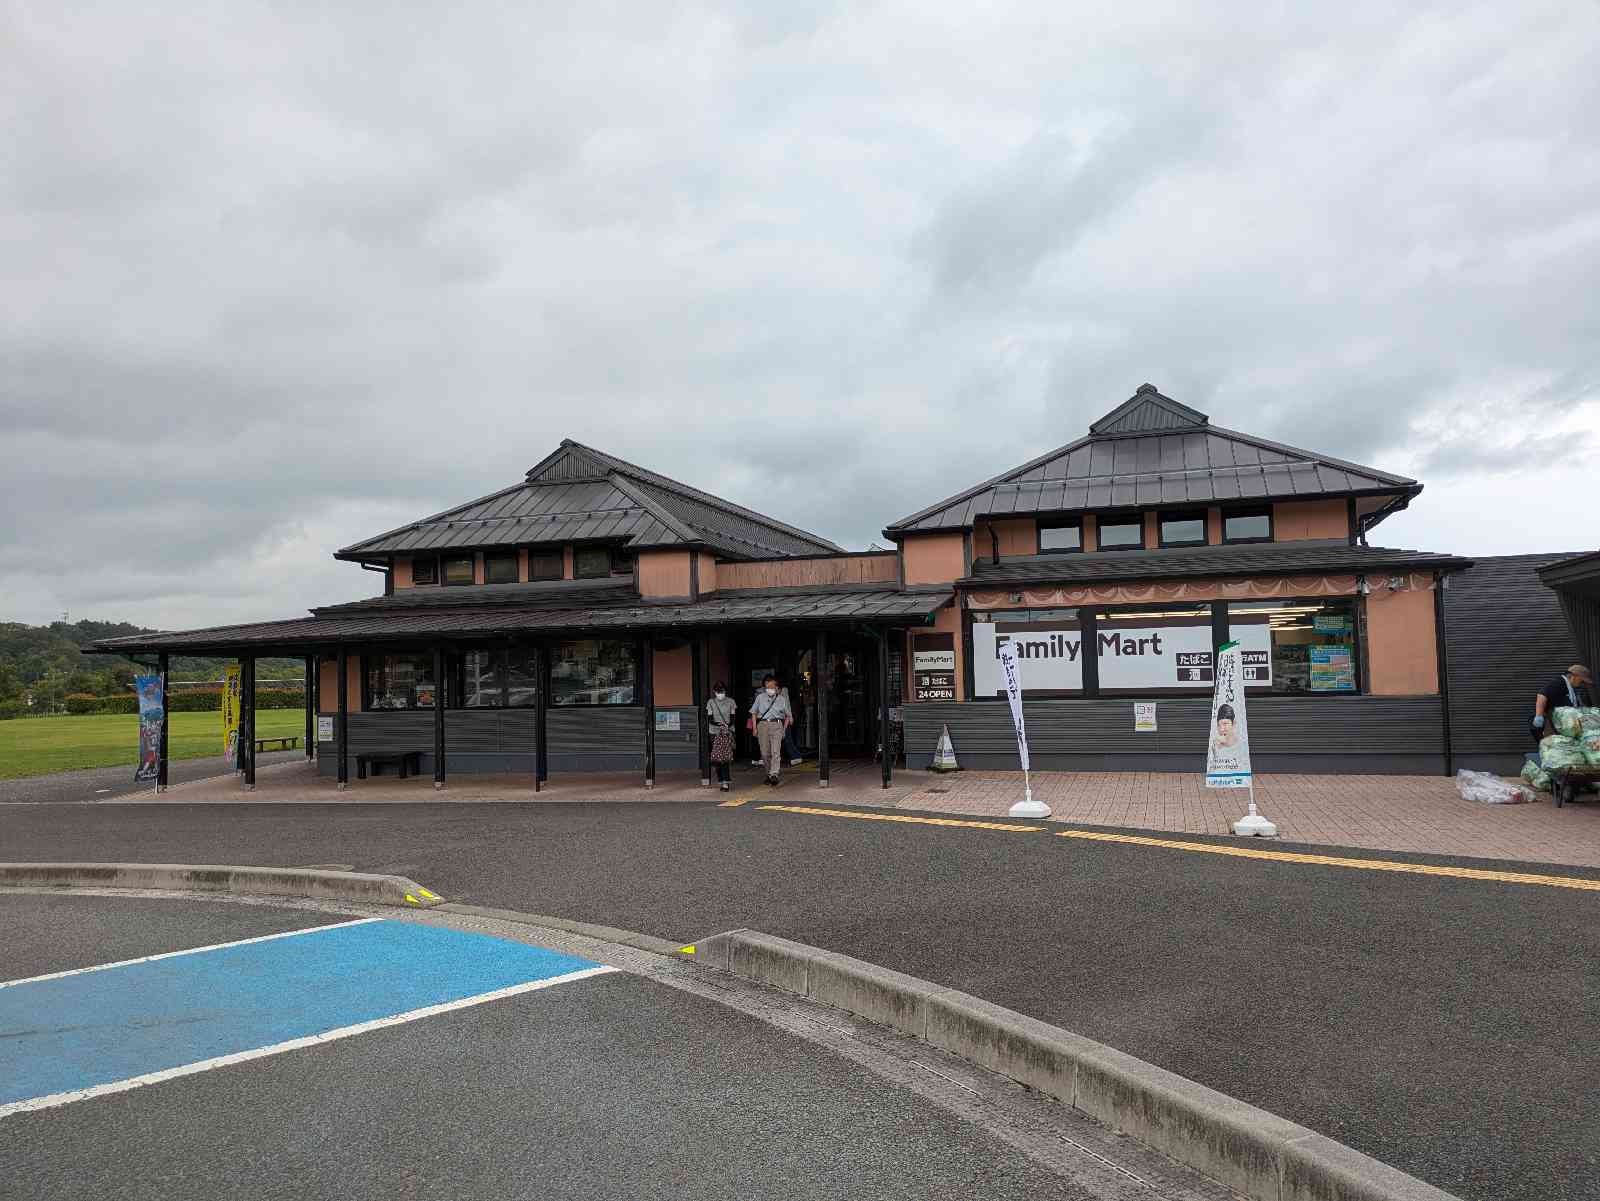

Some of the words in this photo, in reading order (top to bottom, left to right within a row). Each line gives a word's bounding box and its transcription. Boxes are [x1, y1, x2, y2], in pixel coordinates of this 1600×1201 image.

[915, 656, 953, 664] FamilyMart
[1179, 654, 1210, 665] たばこ
